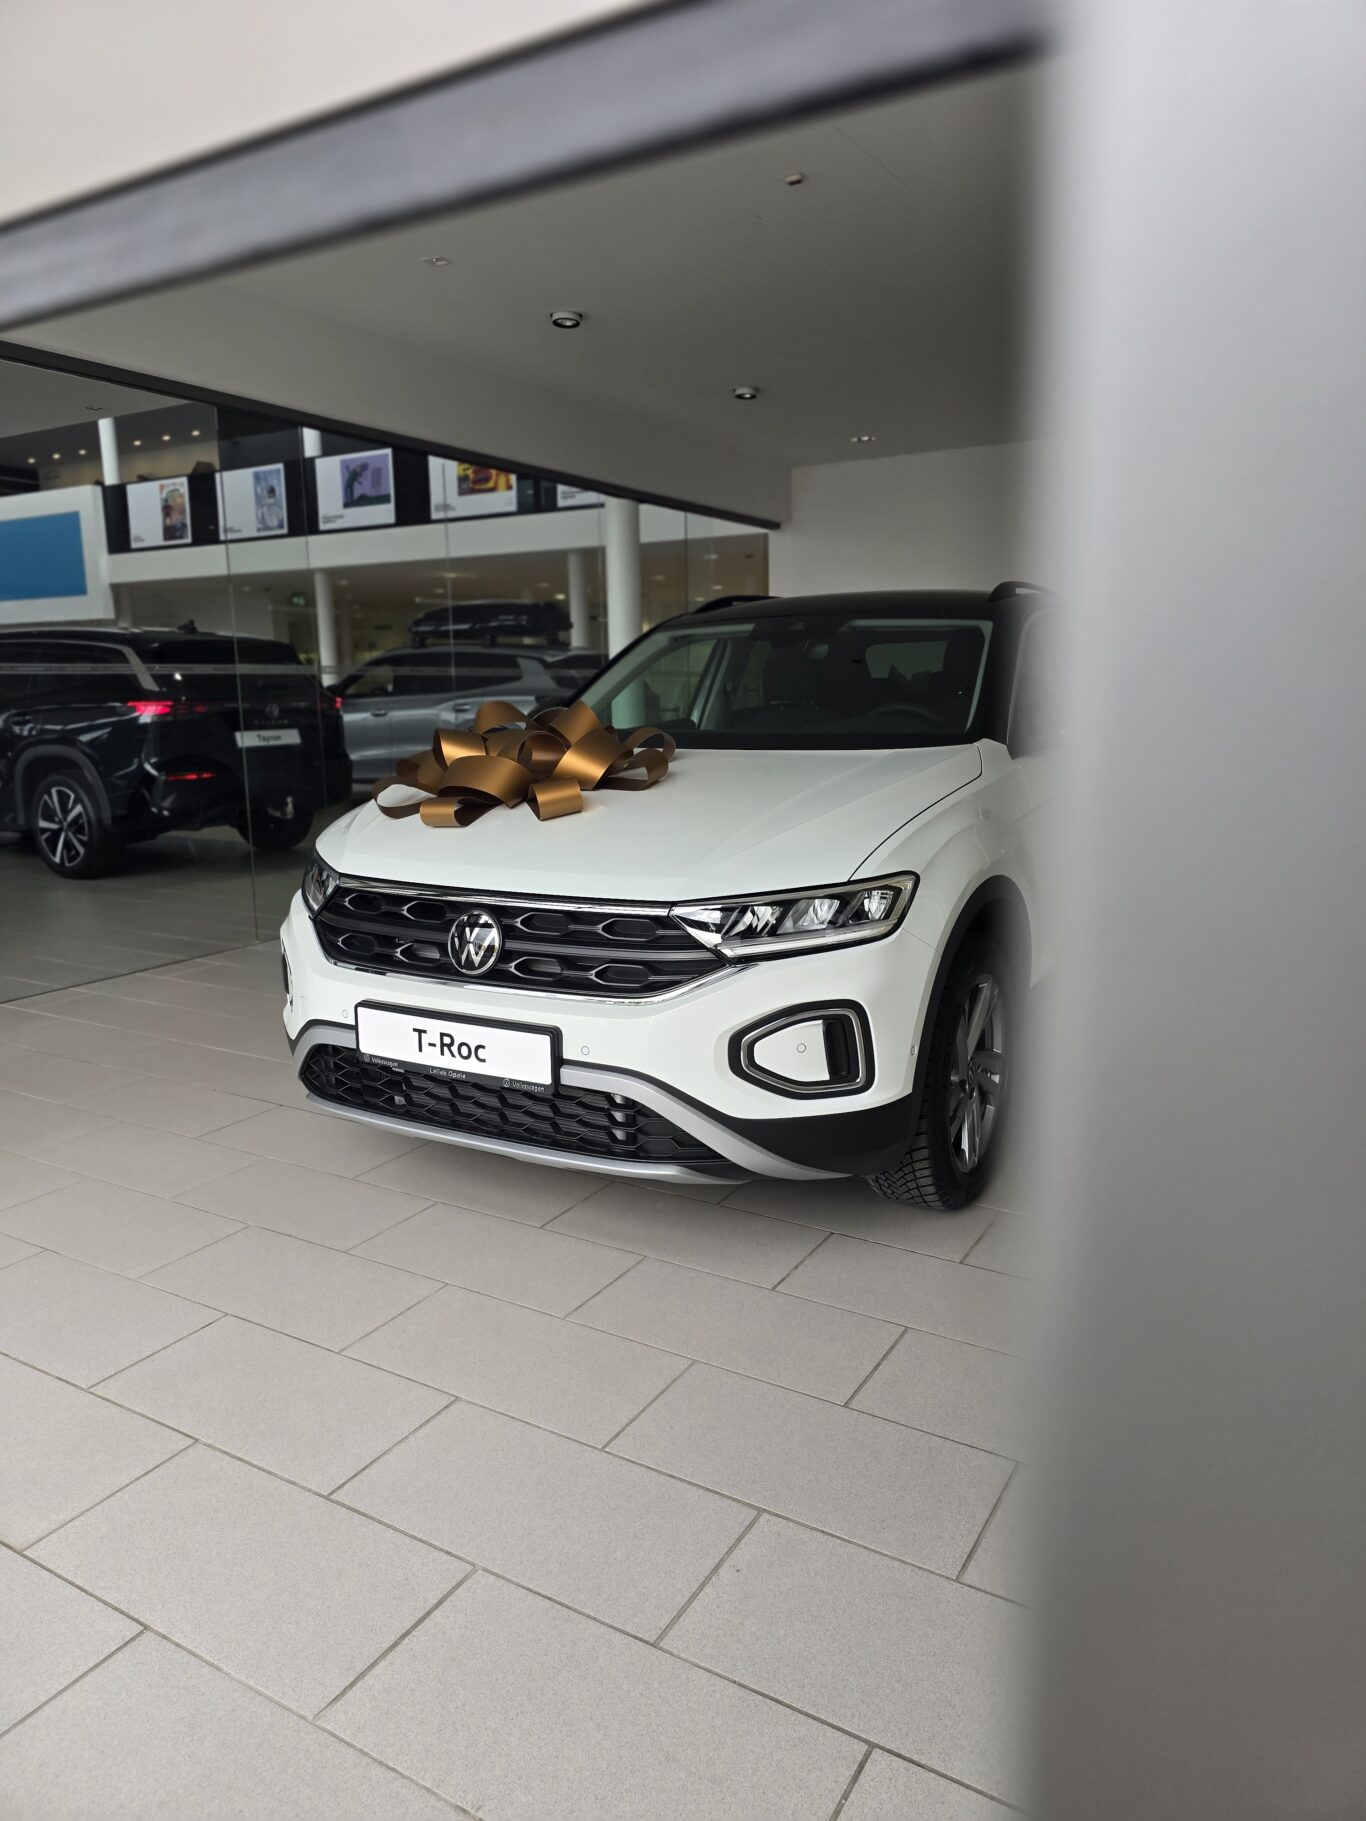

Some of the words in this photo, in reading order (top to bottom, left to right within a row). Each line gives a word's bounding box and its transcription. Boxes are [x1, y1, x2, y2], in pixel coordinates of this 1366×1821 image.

[412, 1027, 487, 1063] T-Roc
[371, 1056, 399, 1068] Volkswagen
[448, 1070, 466, 1080] Opole
[512, 1080, 545, 1093] Volkswagen
